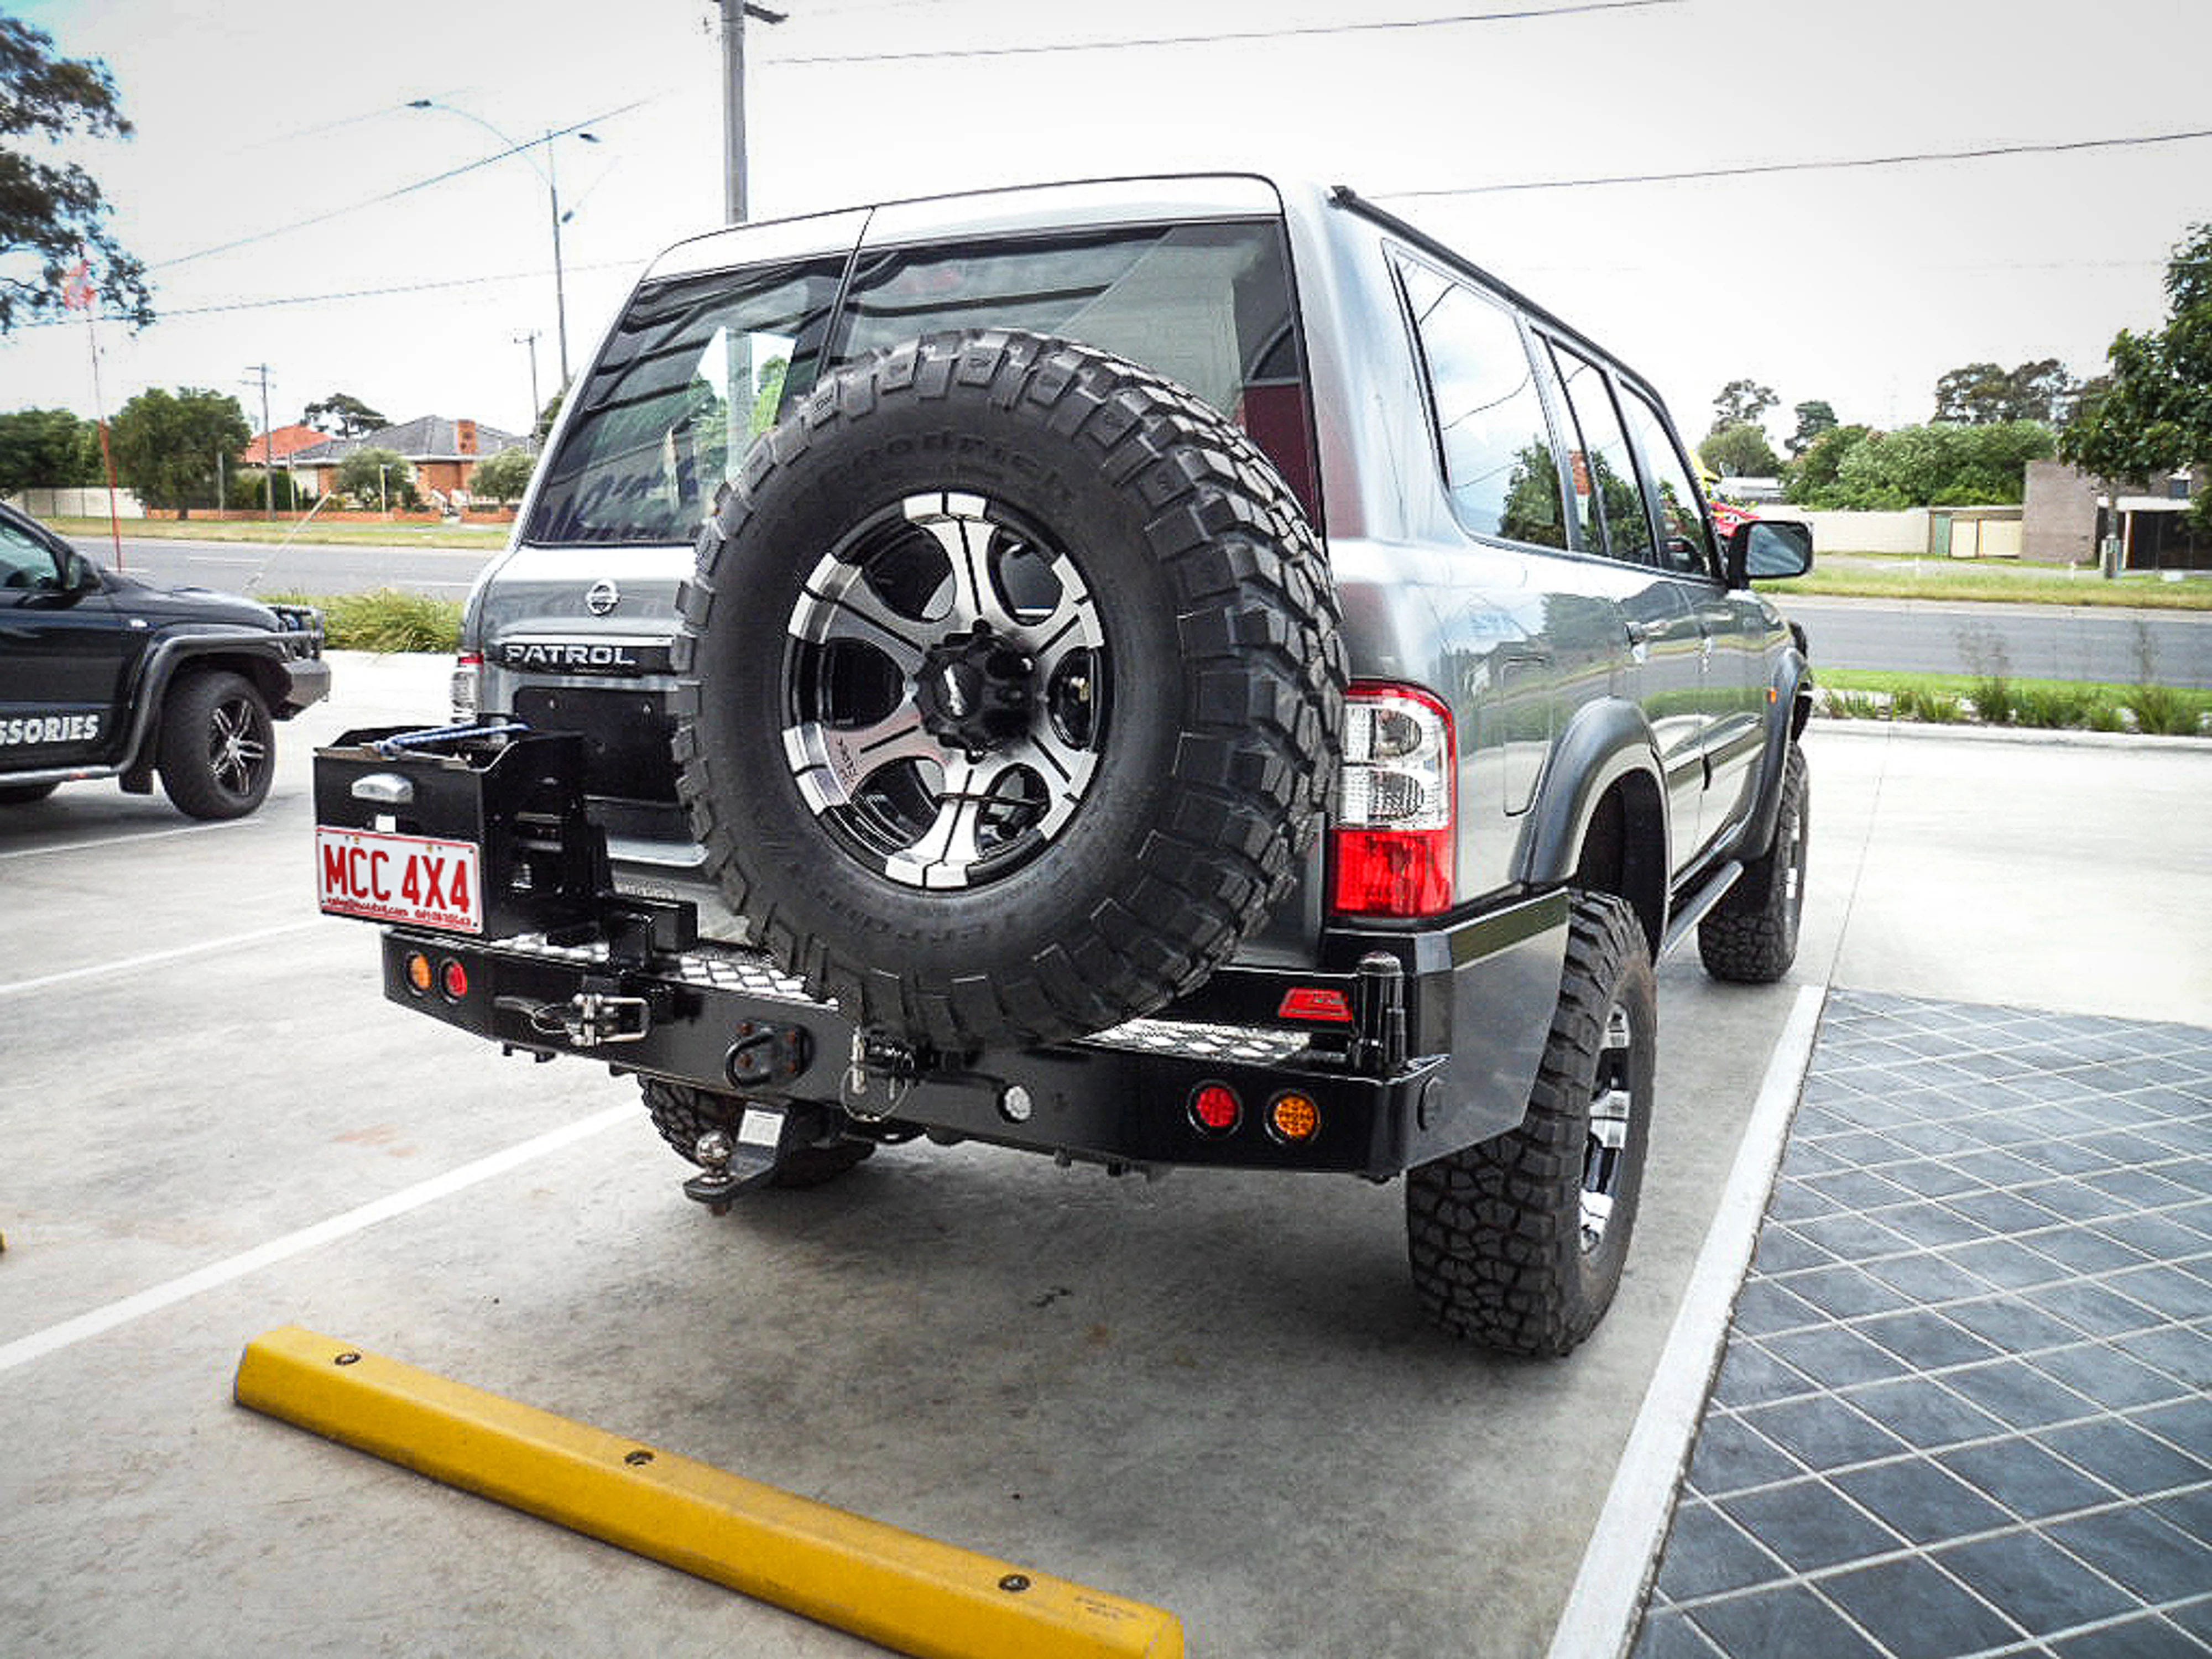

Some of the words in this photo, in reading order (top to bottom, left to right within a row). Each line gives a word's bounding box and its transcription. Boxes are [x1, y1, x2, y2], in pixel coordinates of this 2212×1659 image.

[504, 644, 636, 664] PATROL
[324, 844, 392, 901] MCC
[401, 854, 469, 914] 4X4
